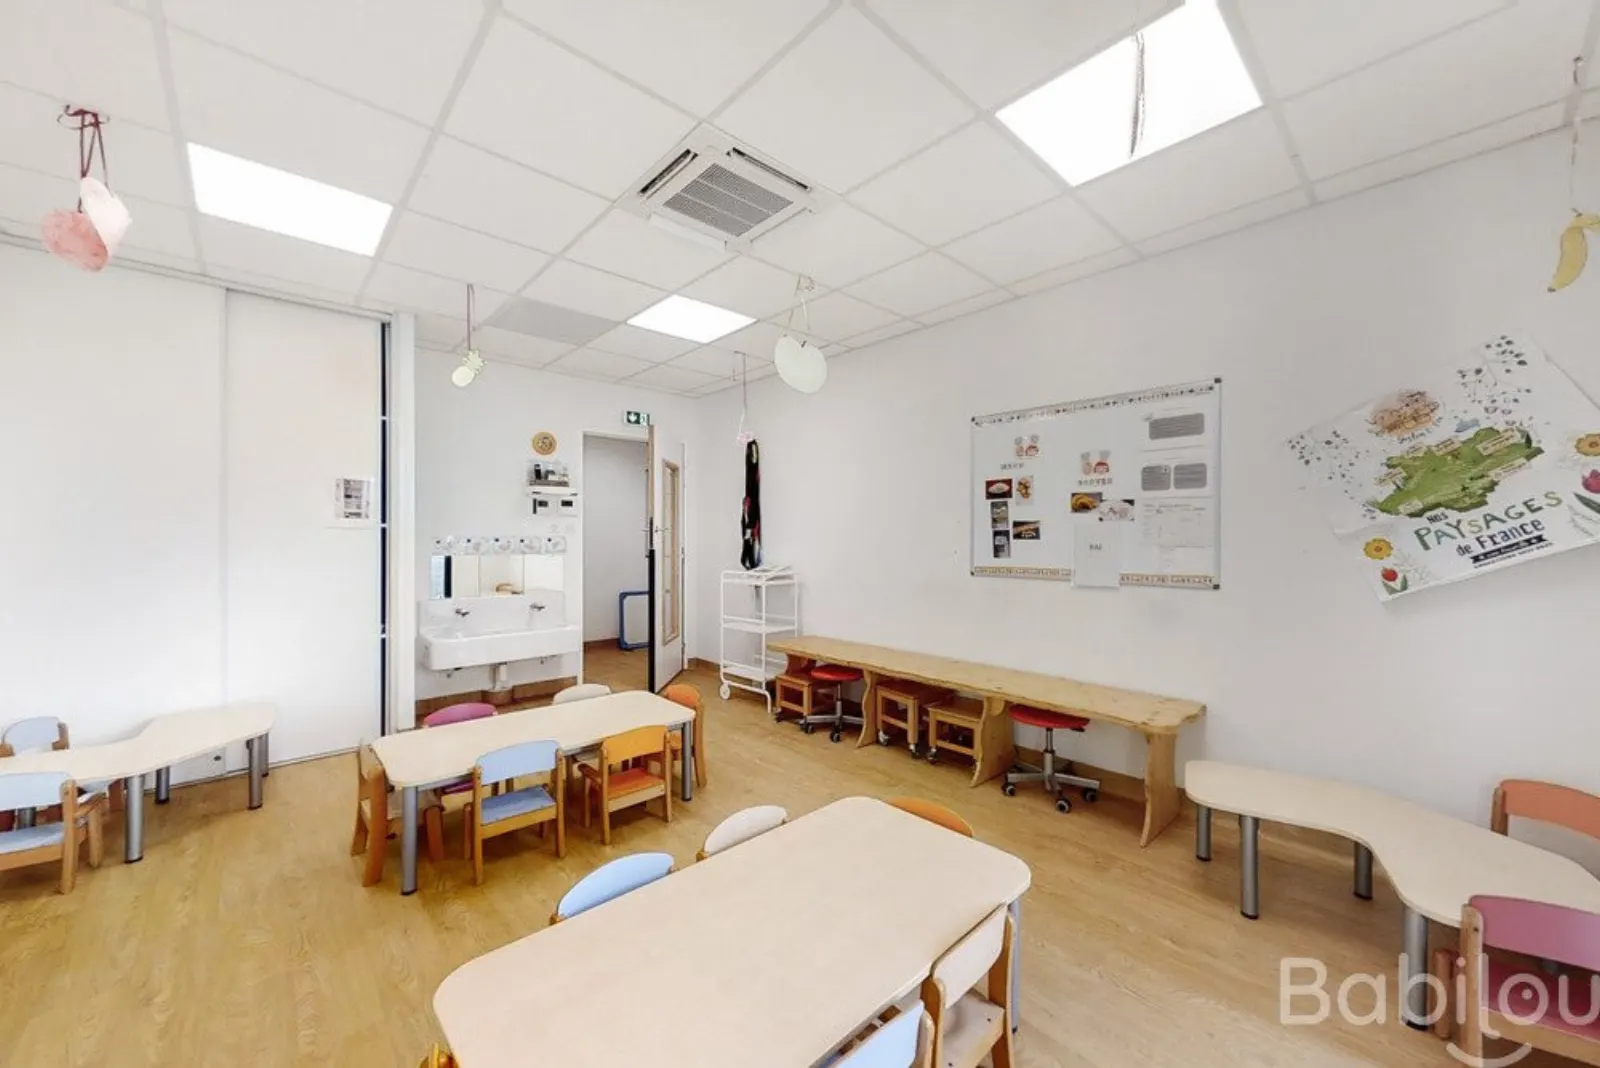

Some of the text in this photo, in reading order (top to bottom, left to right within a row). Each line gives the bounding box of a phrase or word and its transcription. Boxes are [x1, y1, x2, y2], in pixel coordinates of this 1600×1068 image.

[1414, 490, 1563, 551] PAYSAGES
[1456, 543, 1472, 557] de
[1475, 518, 1545, 550] France
